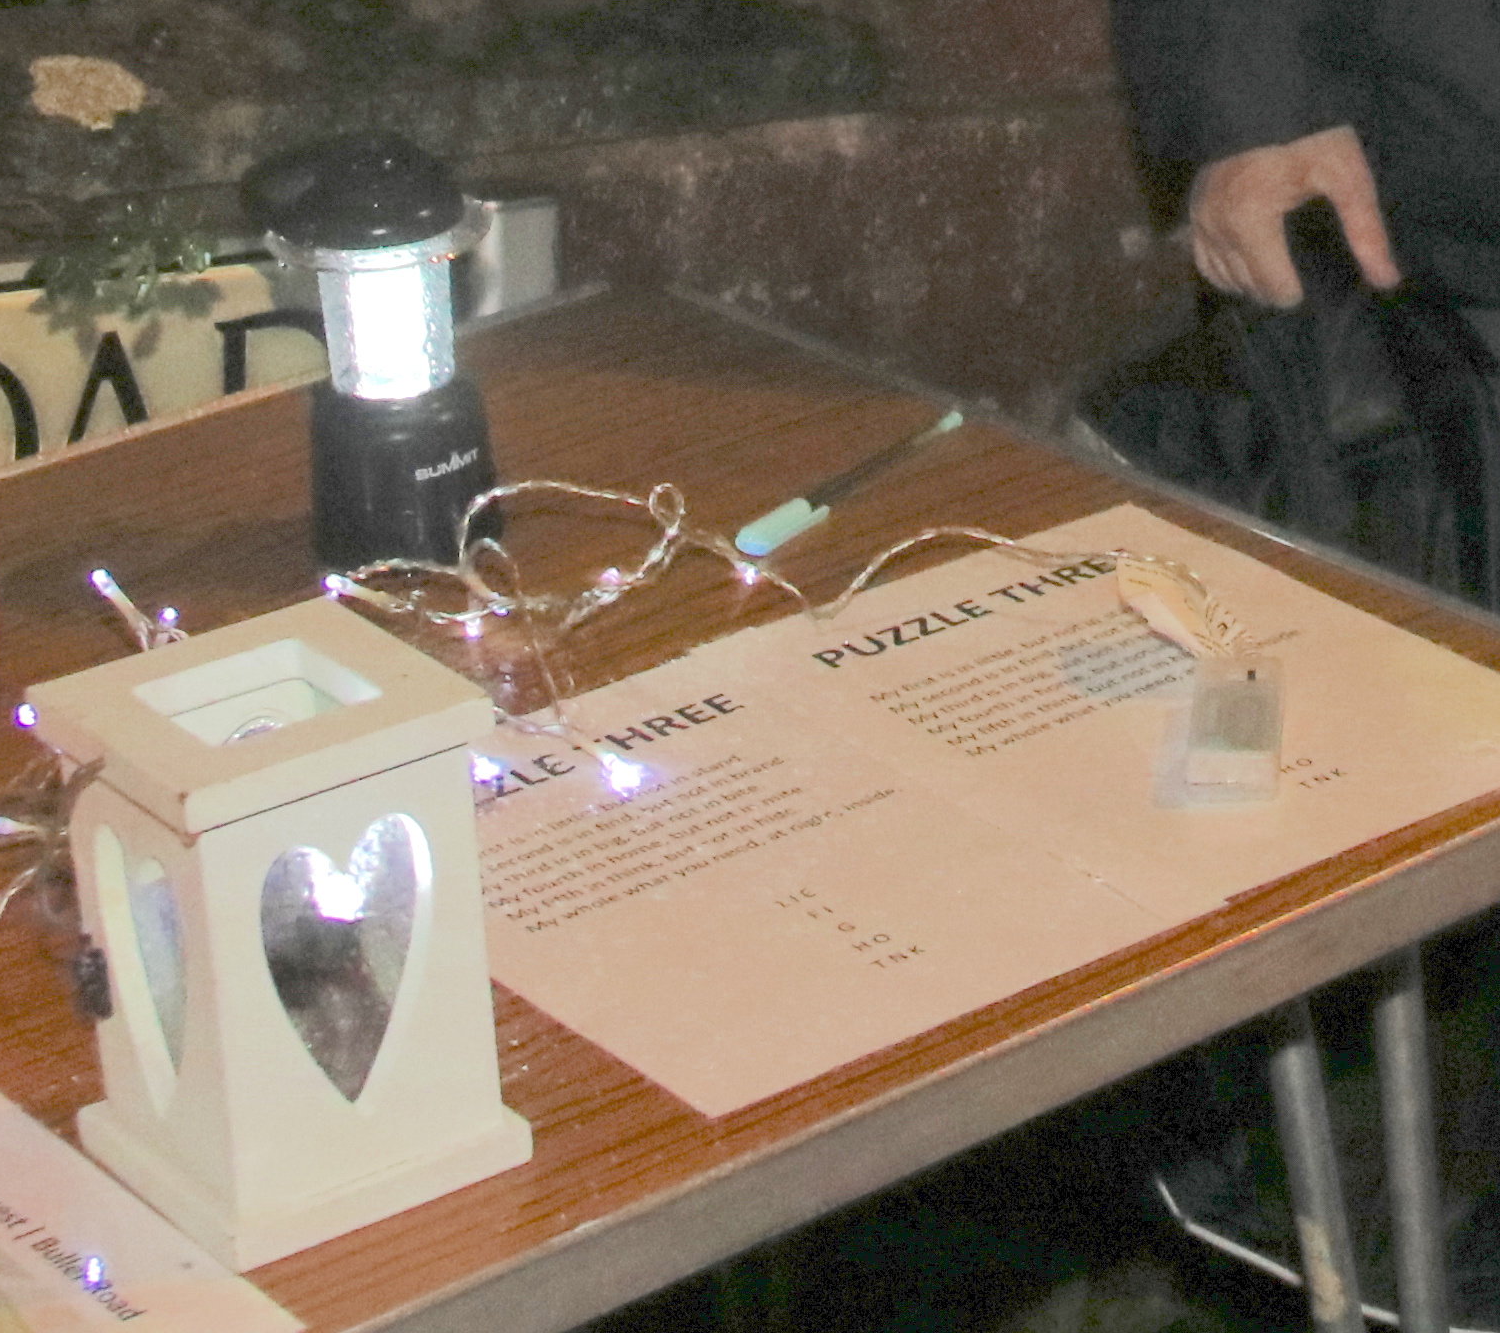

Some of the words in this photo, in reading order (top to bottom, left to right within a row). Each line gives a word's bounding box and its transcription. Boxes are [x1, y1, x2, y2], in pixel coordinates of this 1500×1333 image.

[414, 447, 479, 481] SUMMIT
[812, 599, 993, 669] PUZZLE
[988, 557, 1118, 603] THRE
[852, 933, 891, 952] HO
[871, 944, 926, 969] TNK
